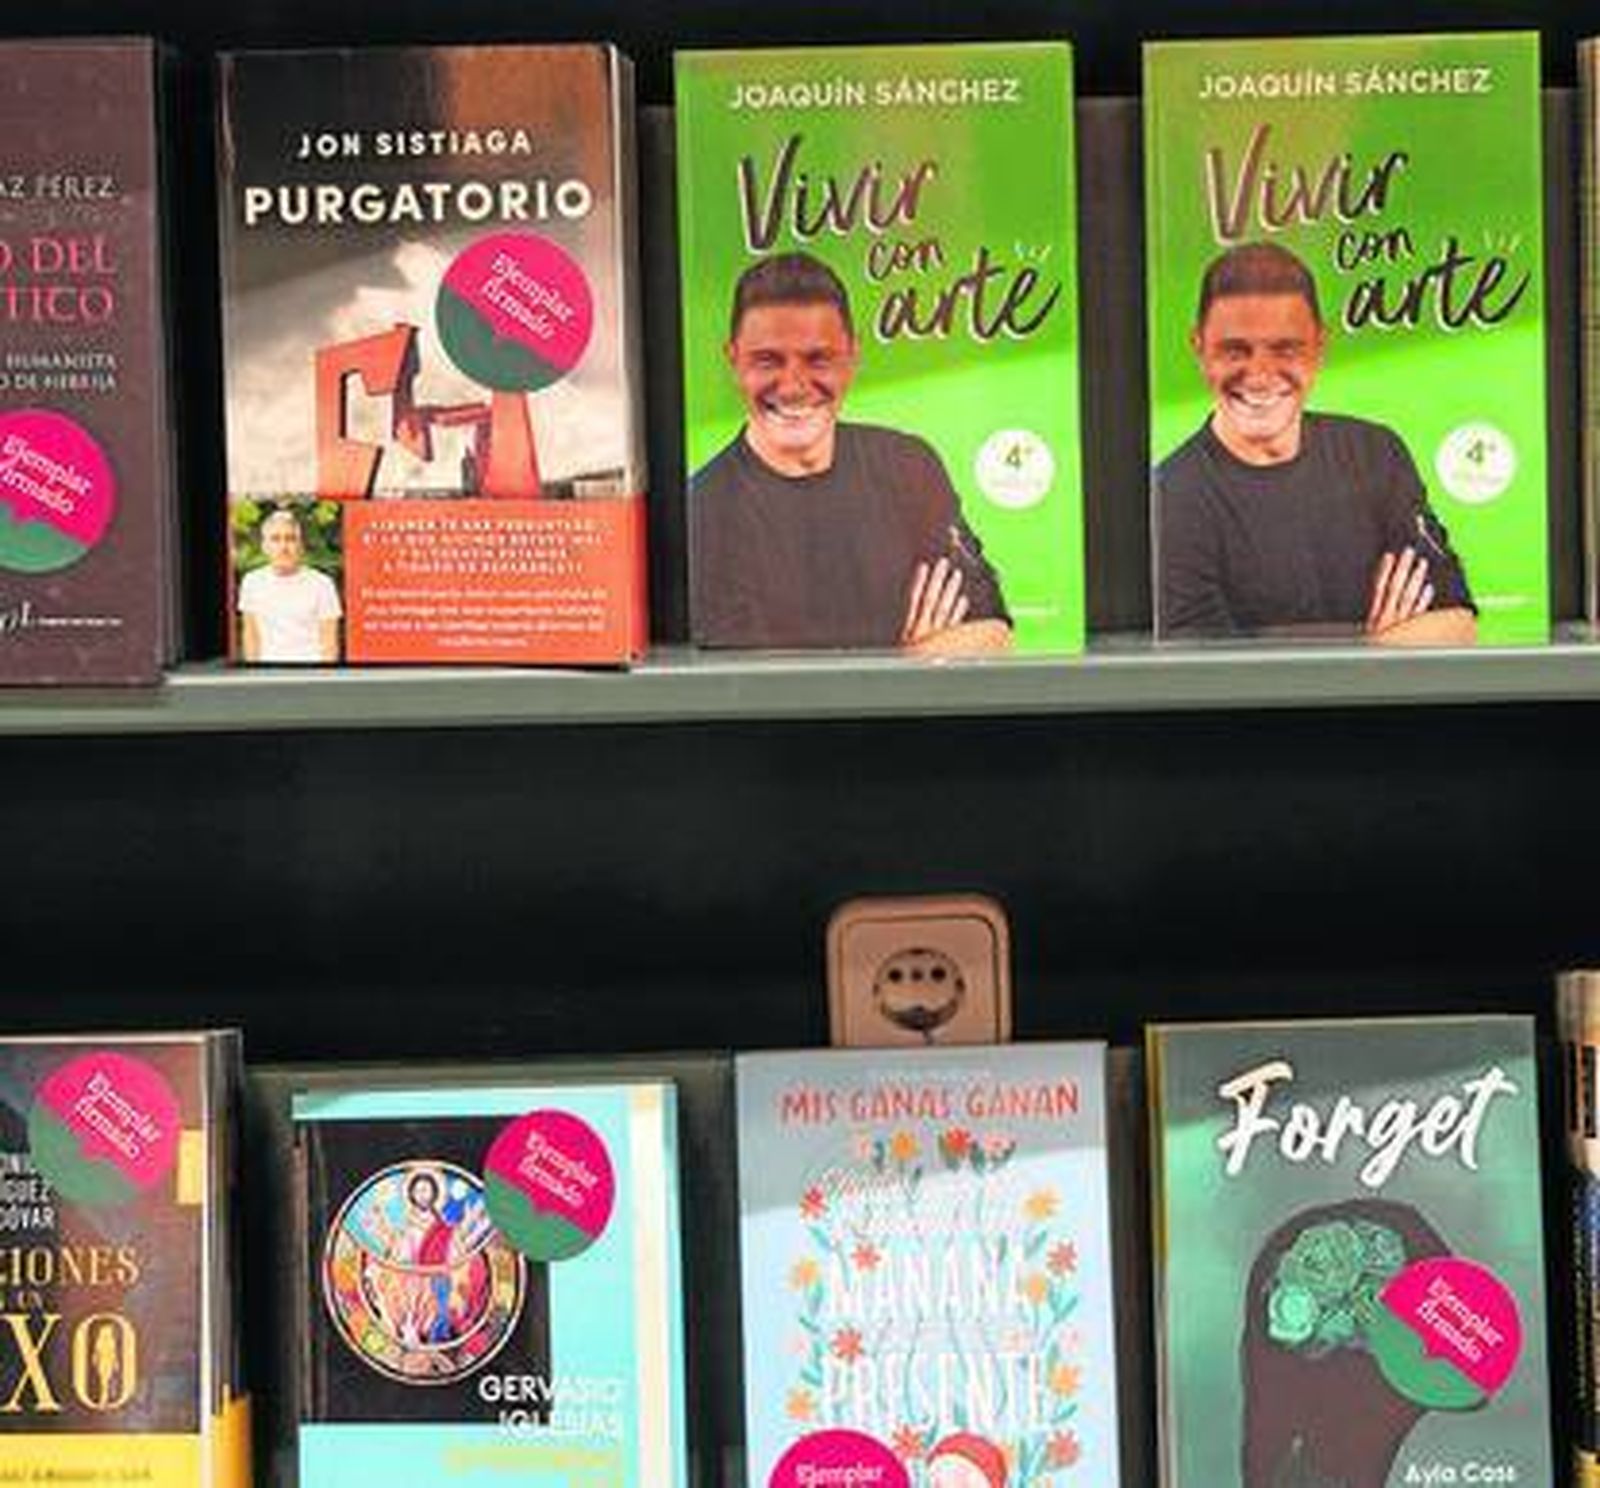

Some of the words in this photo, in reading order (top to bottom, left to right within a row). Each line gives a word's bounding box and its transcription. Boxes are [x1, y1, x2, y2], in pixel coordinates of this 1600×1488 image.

[732, 78, 866, 109] JOAQUÍN
[875, 75, 1021, 105] SÁNCHEZ
[1199, 69, 1336, 99] JOAQUÍN
[1345, 64, 1493, 95] SÁNCHEZ
[298, 133, 361, 158] JON
[376, 130, 532, 156] SISTIAGA
[244, 179, 593, 225] PURGATORIO
[737, 130, 938, 255] Vivir
[1206, 123, 1409, 248] Vivir
[32, 234, 118, 274] DEL
[865, 241, 944, 283] con
[1334, 226, 1414, 275] con
[875, 245, 1063, 343] arte
[1345, 234, 1531, 332] arte
[781, 1090, 836, 1125] MIS
[965, 1079, 1080, 1119] GANAN
[1217, 1060, 1519, 1187] Forget
[0, 1247, 139, 1286] IONES
[0, 1312, 137, 1411] XO
